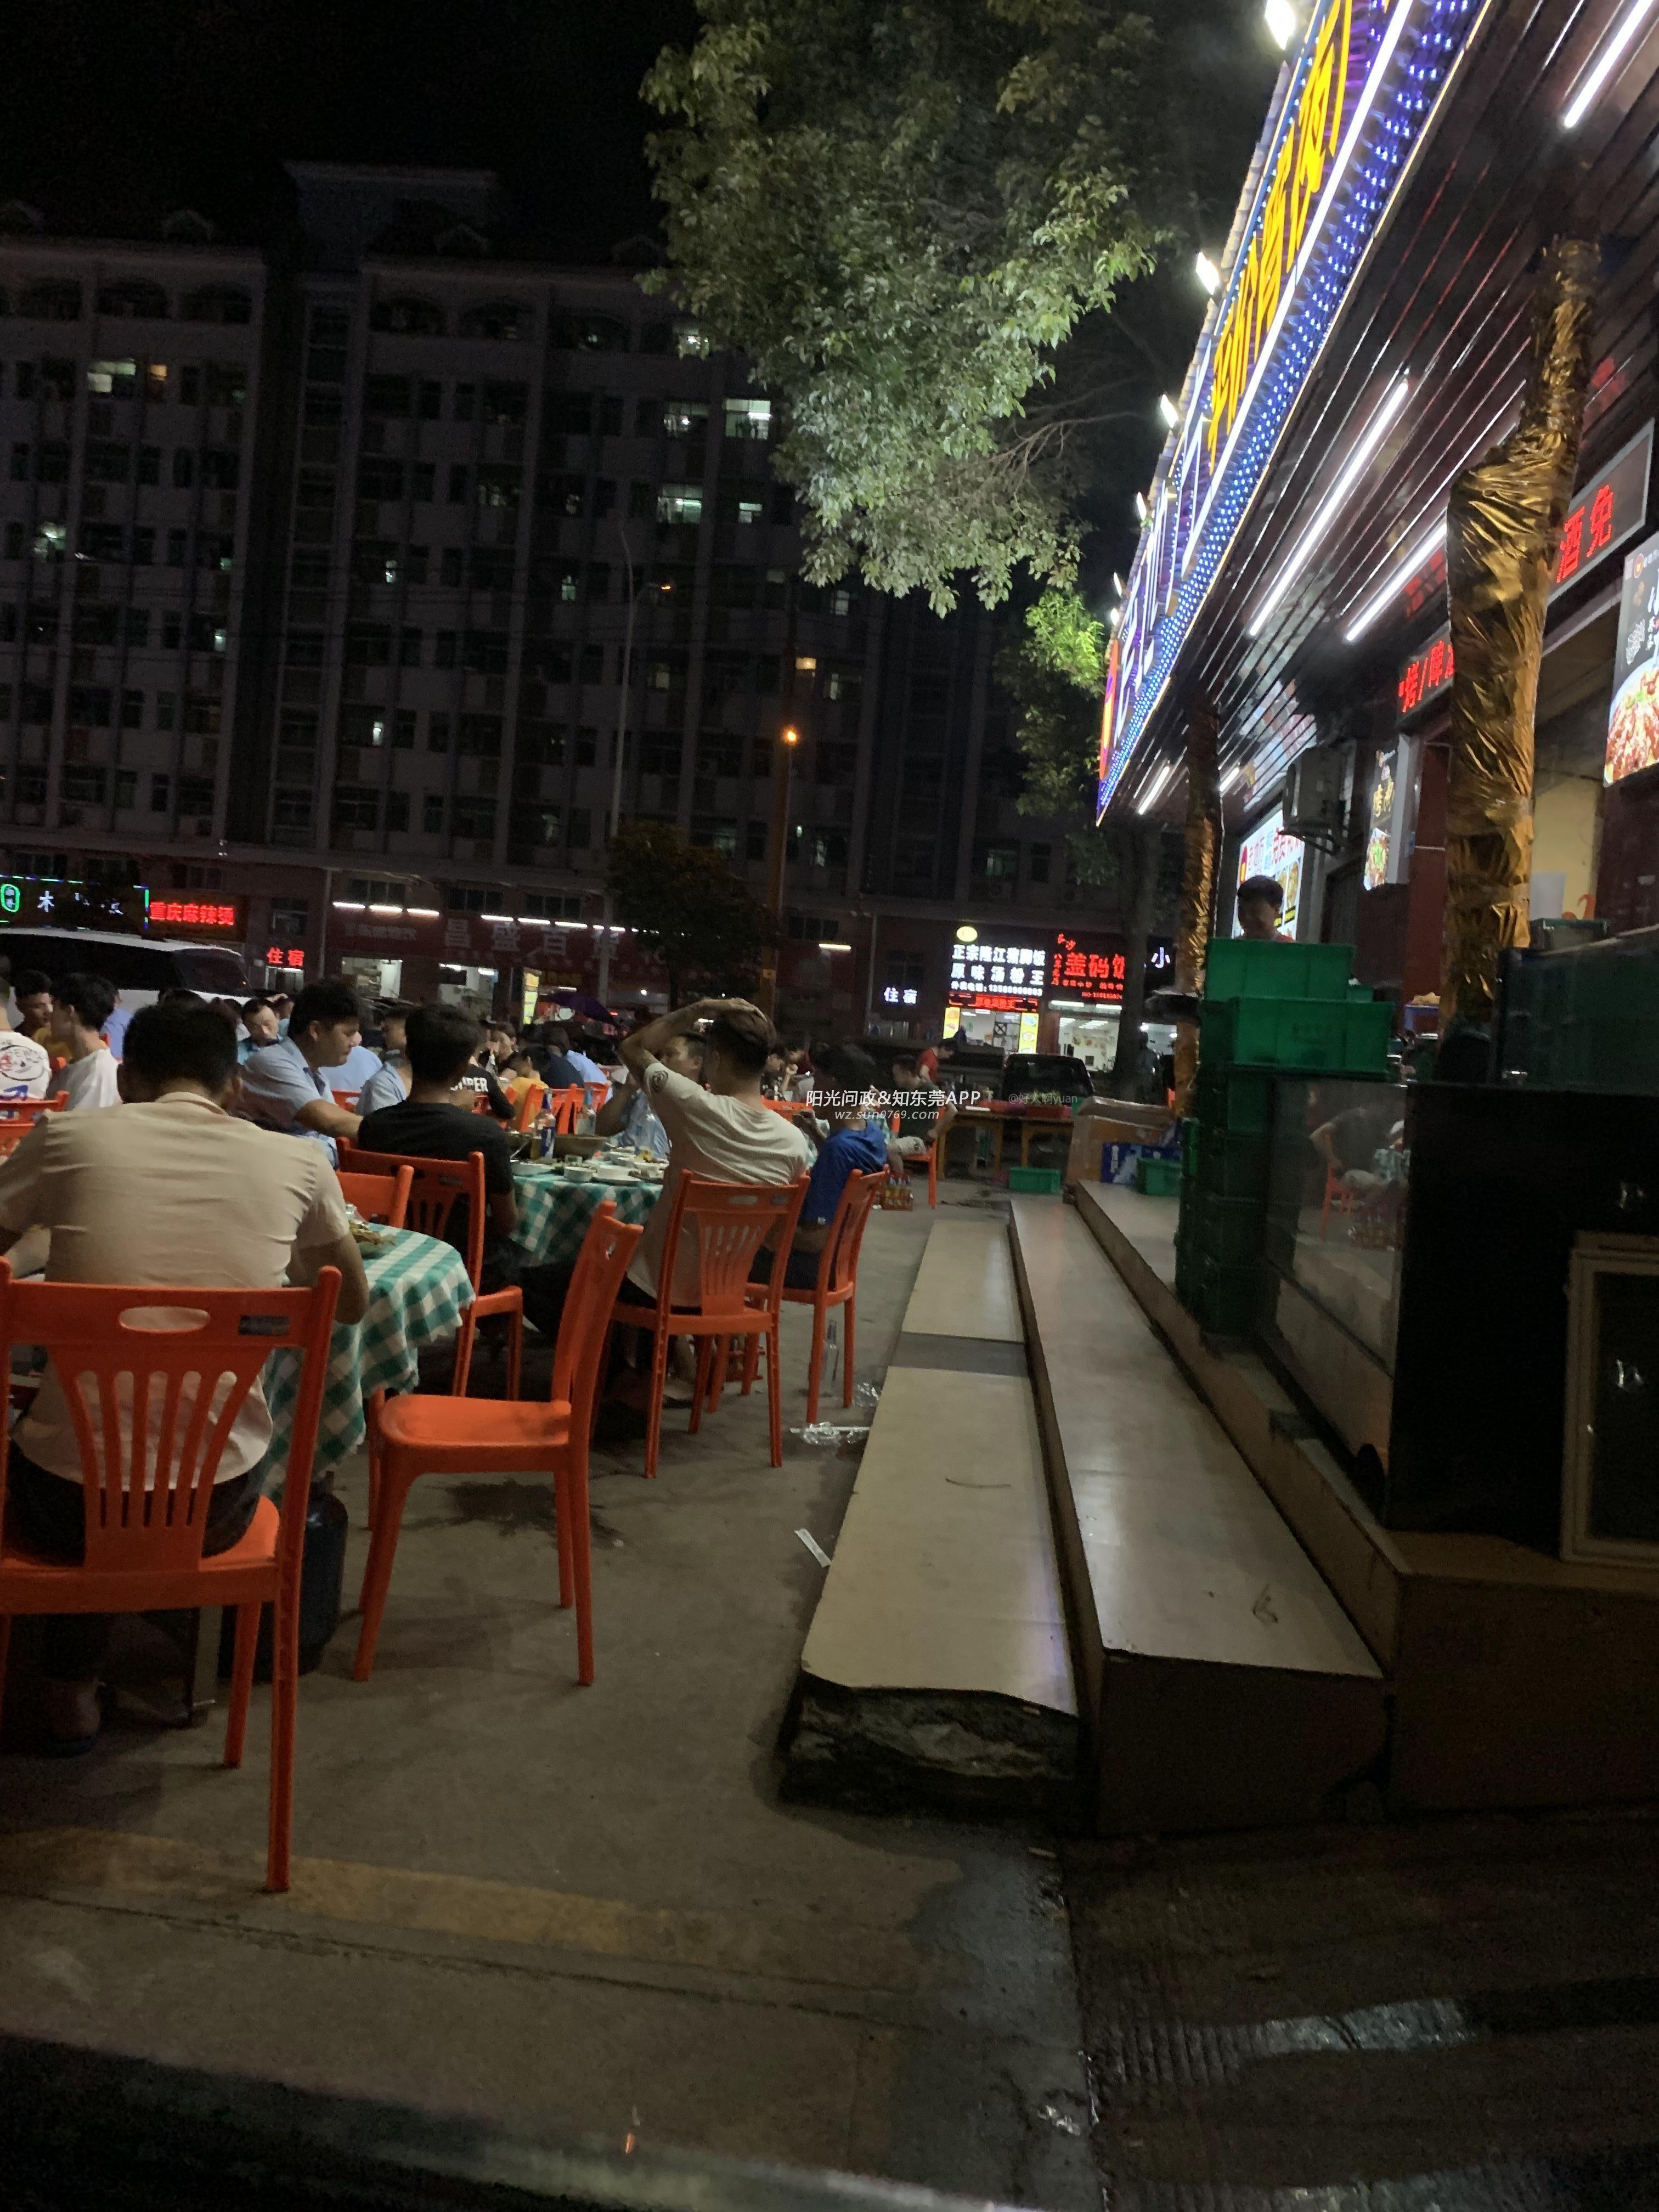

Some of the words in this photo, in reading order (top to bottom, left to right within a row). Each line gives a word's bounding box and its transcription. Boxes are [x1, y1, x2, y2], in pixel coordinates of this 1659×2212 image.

[150, 901, 234, 926] 重庆麻辣烫
[267, 947, 305, 967] 住宿
[952, 944, 1046, 967] 正宗隆江猪脚饭
[1151, 946, 1171, 969] 小
[950, 962, 1045, 986] 原味汤粉王
[883, 987, 918, 1005] 住宿
